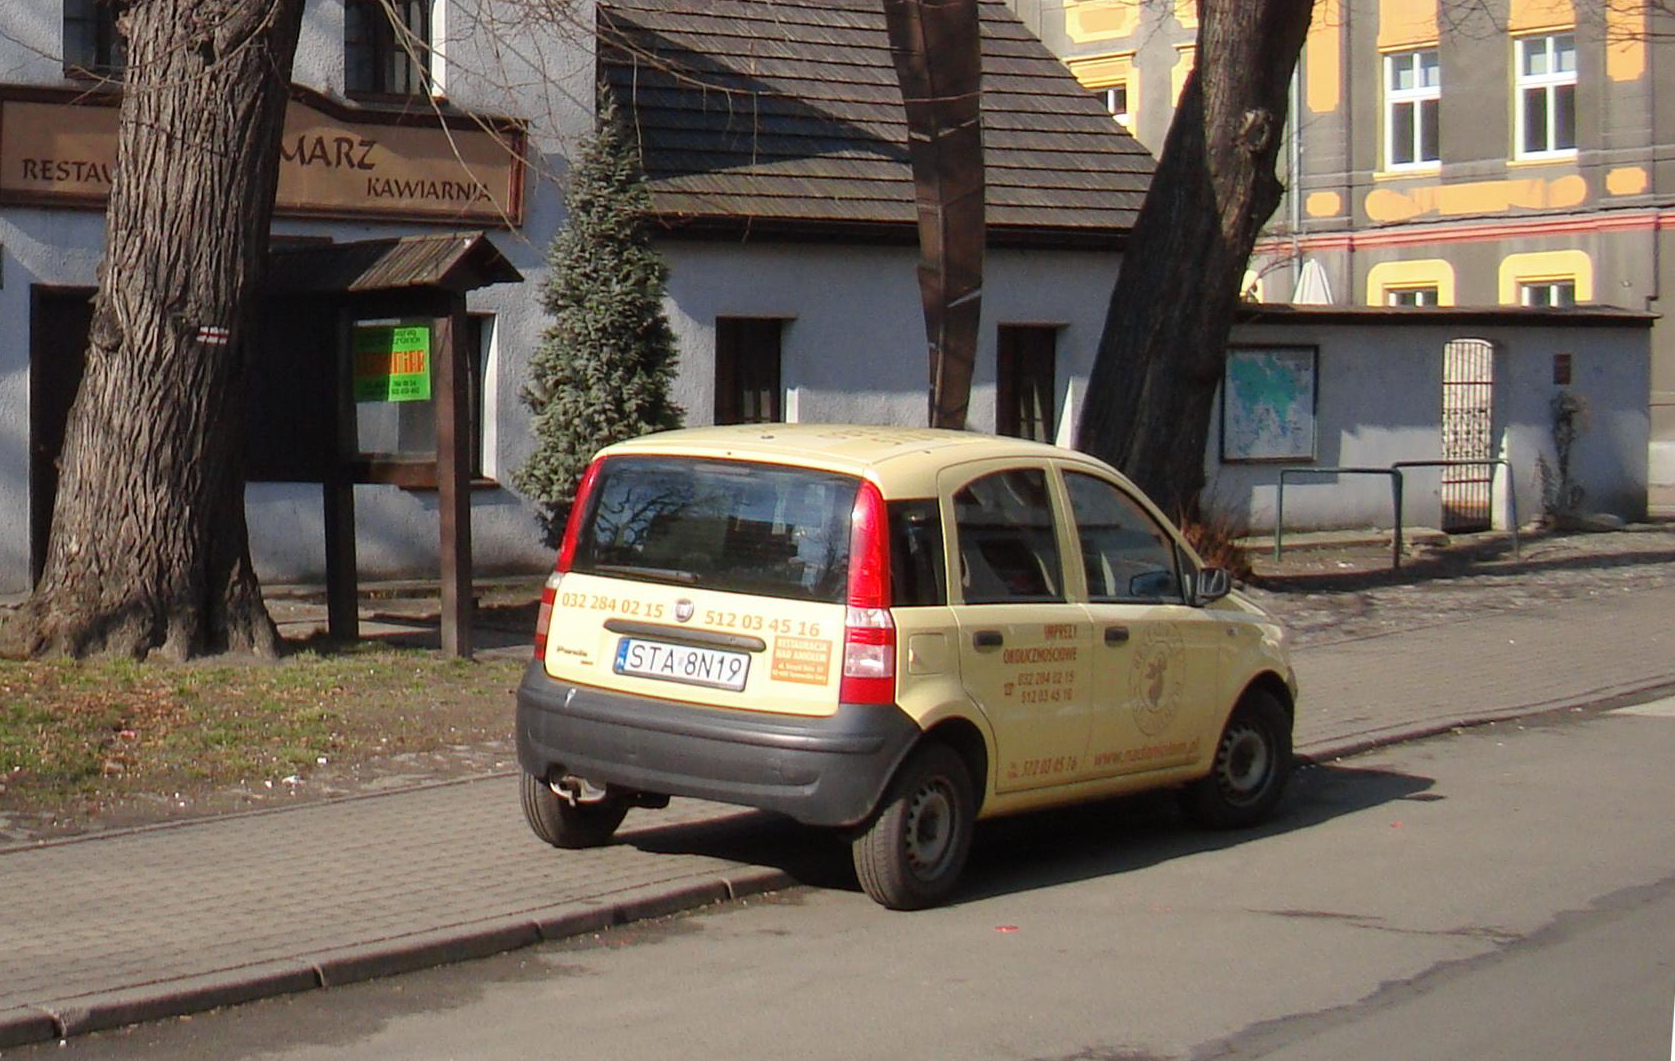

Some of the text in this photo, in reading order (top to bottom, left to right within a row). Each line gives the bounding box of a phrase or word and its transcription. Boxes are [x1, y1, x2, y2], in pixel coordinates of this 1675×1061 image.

[366, 177, 492, 202] KAWIARNIA
[562, 592, 665, 619] 032 284 02 15
[704, 610, 821, 637] 512 03 45 16
[629, 644, 675, 674] STA
[684, 651, 743, 683] 8N19
